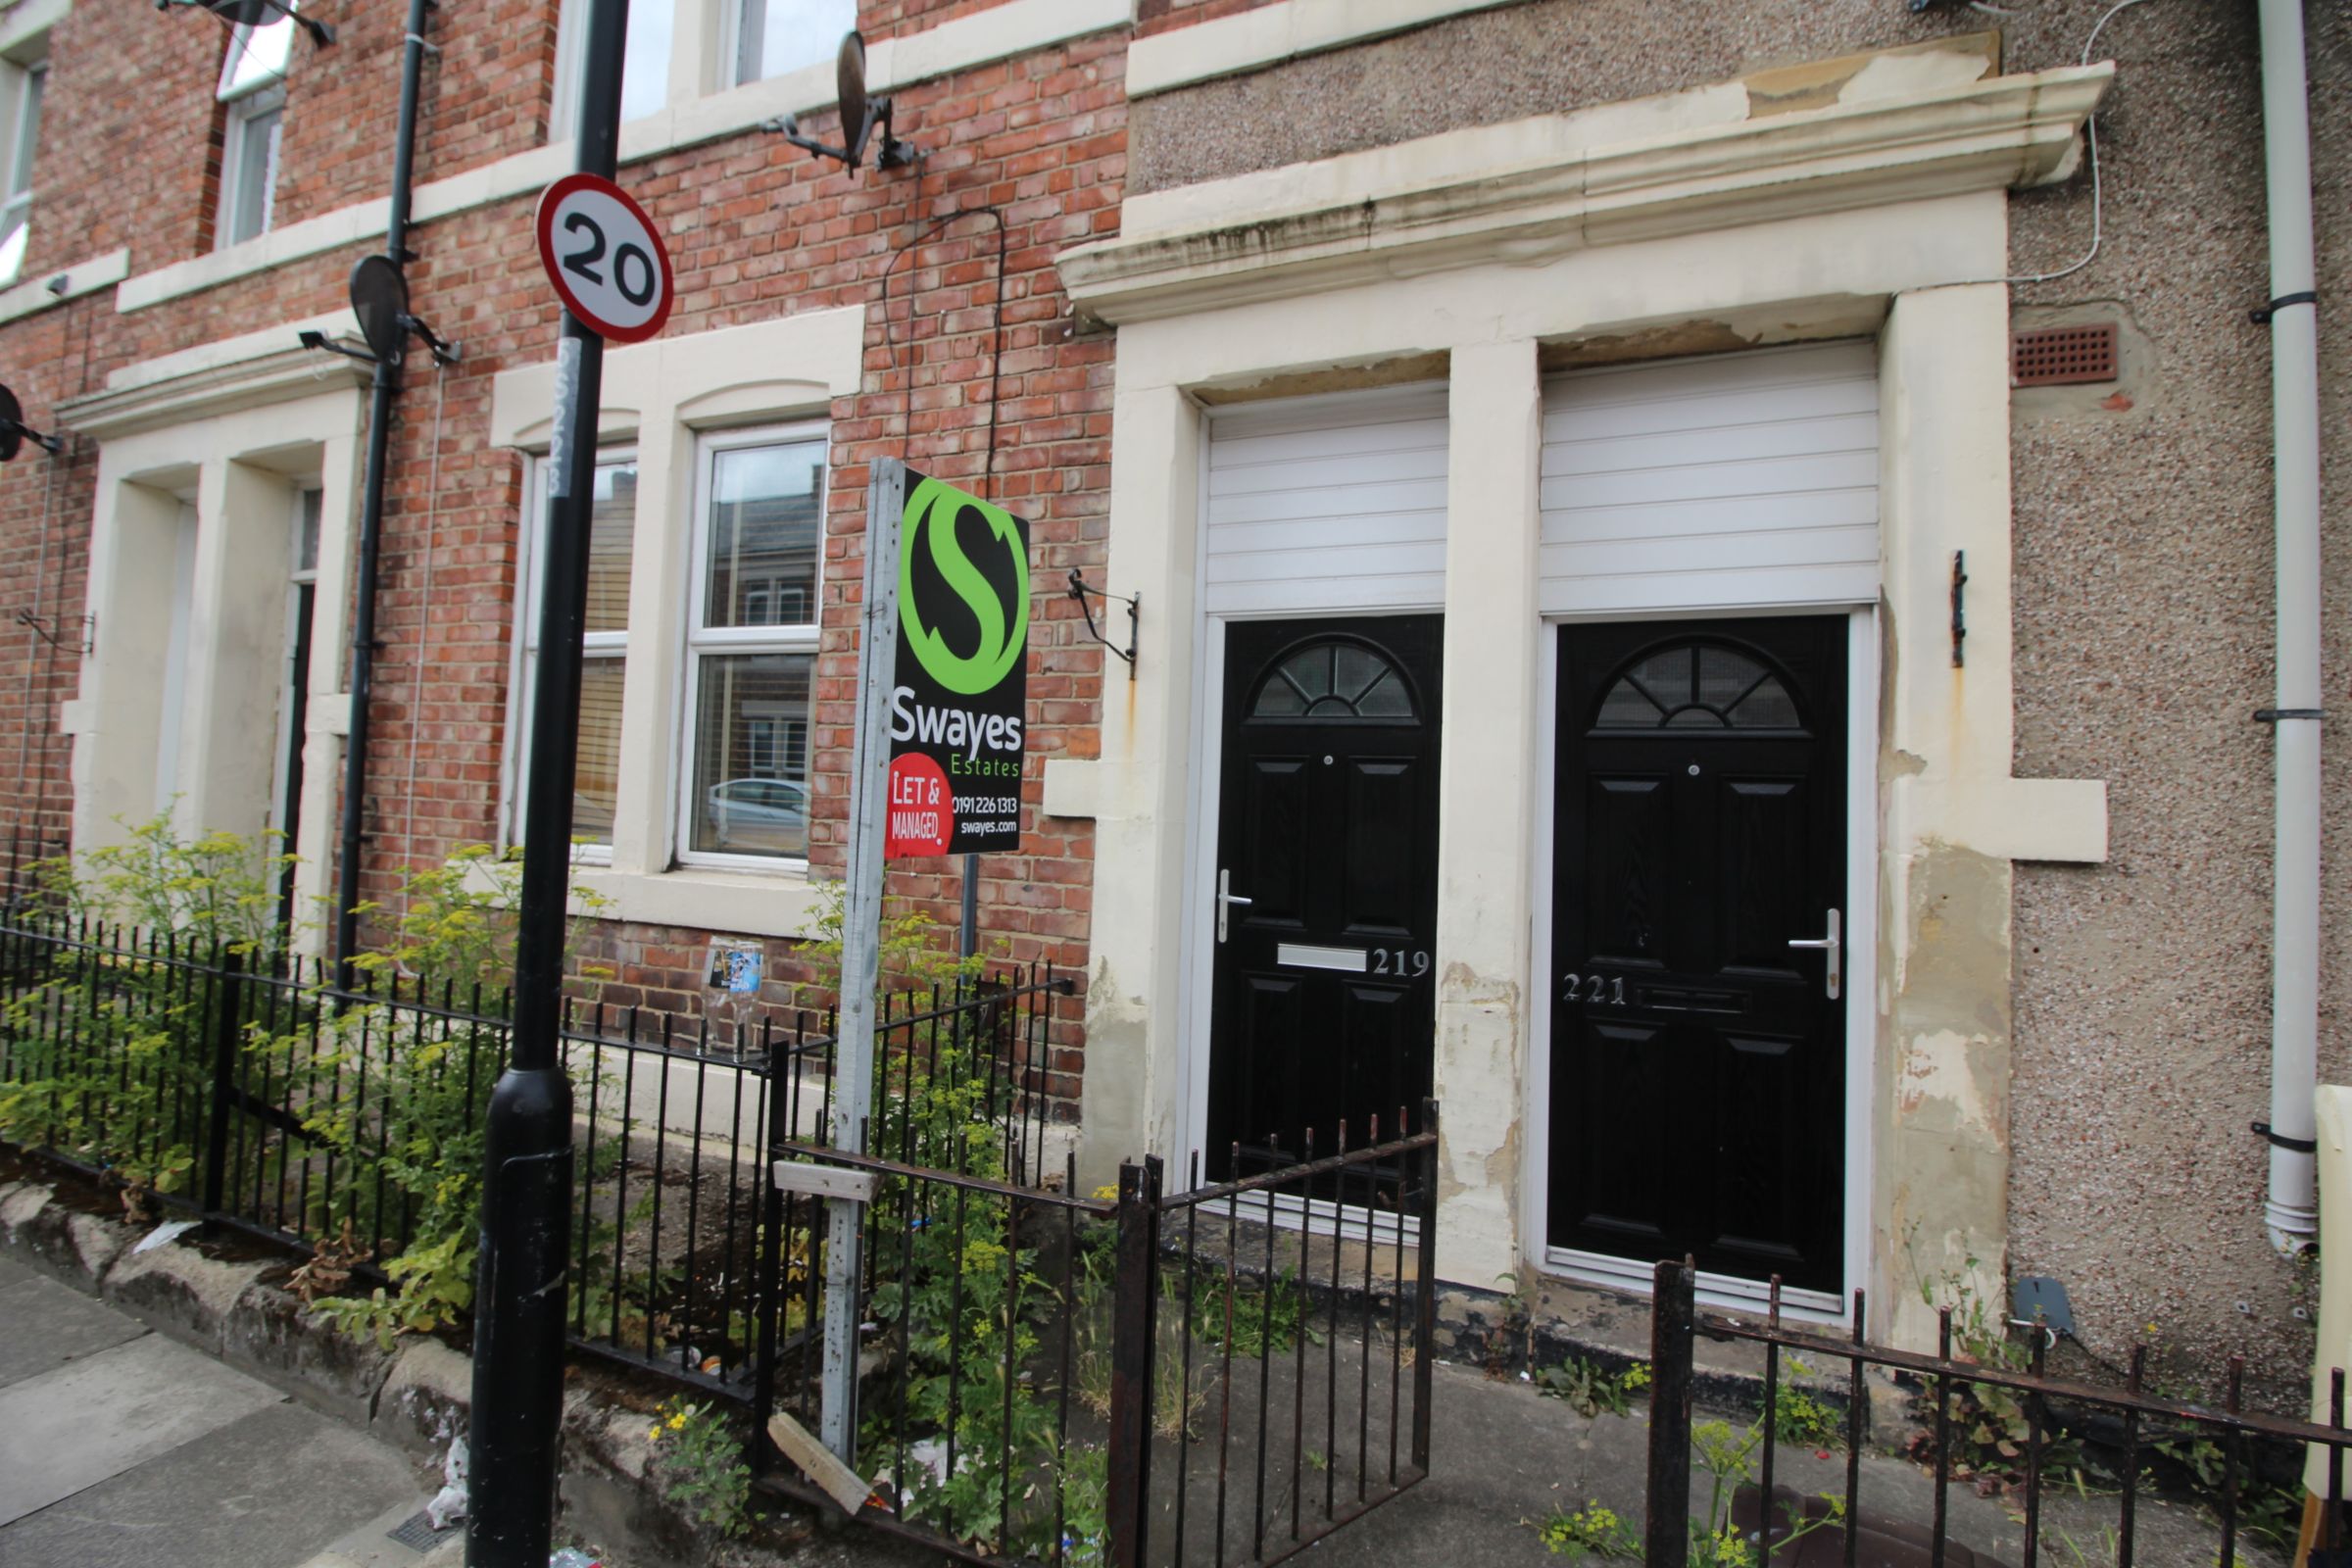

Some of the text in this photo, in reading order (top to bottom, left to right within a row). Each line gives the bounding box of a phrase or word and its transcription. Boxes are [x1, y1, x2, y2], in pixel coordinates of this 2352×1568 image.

[564, 212, 656, 307] 20
[891, 686, 1022, 761] Swayes
[951, 753, 1019, 777] Estates
[893, 773, 940, 805] LET &
[952, 796, 1017, 814] 0191 226 1313
[892, 811, 939, 840] MANAGED
[961, 821, 1017, 837] swayes.com
[1373, 948, 1430, 977] 219
[1563, 973, 1627, 1005] 221
